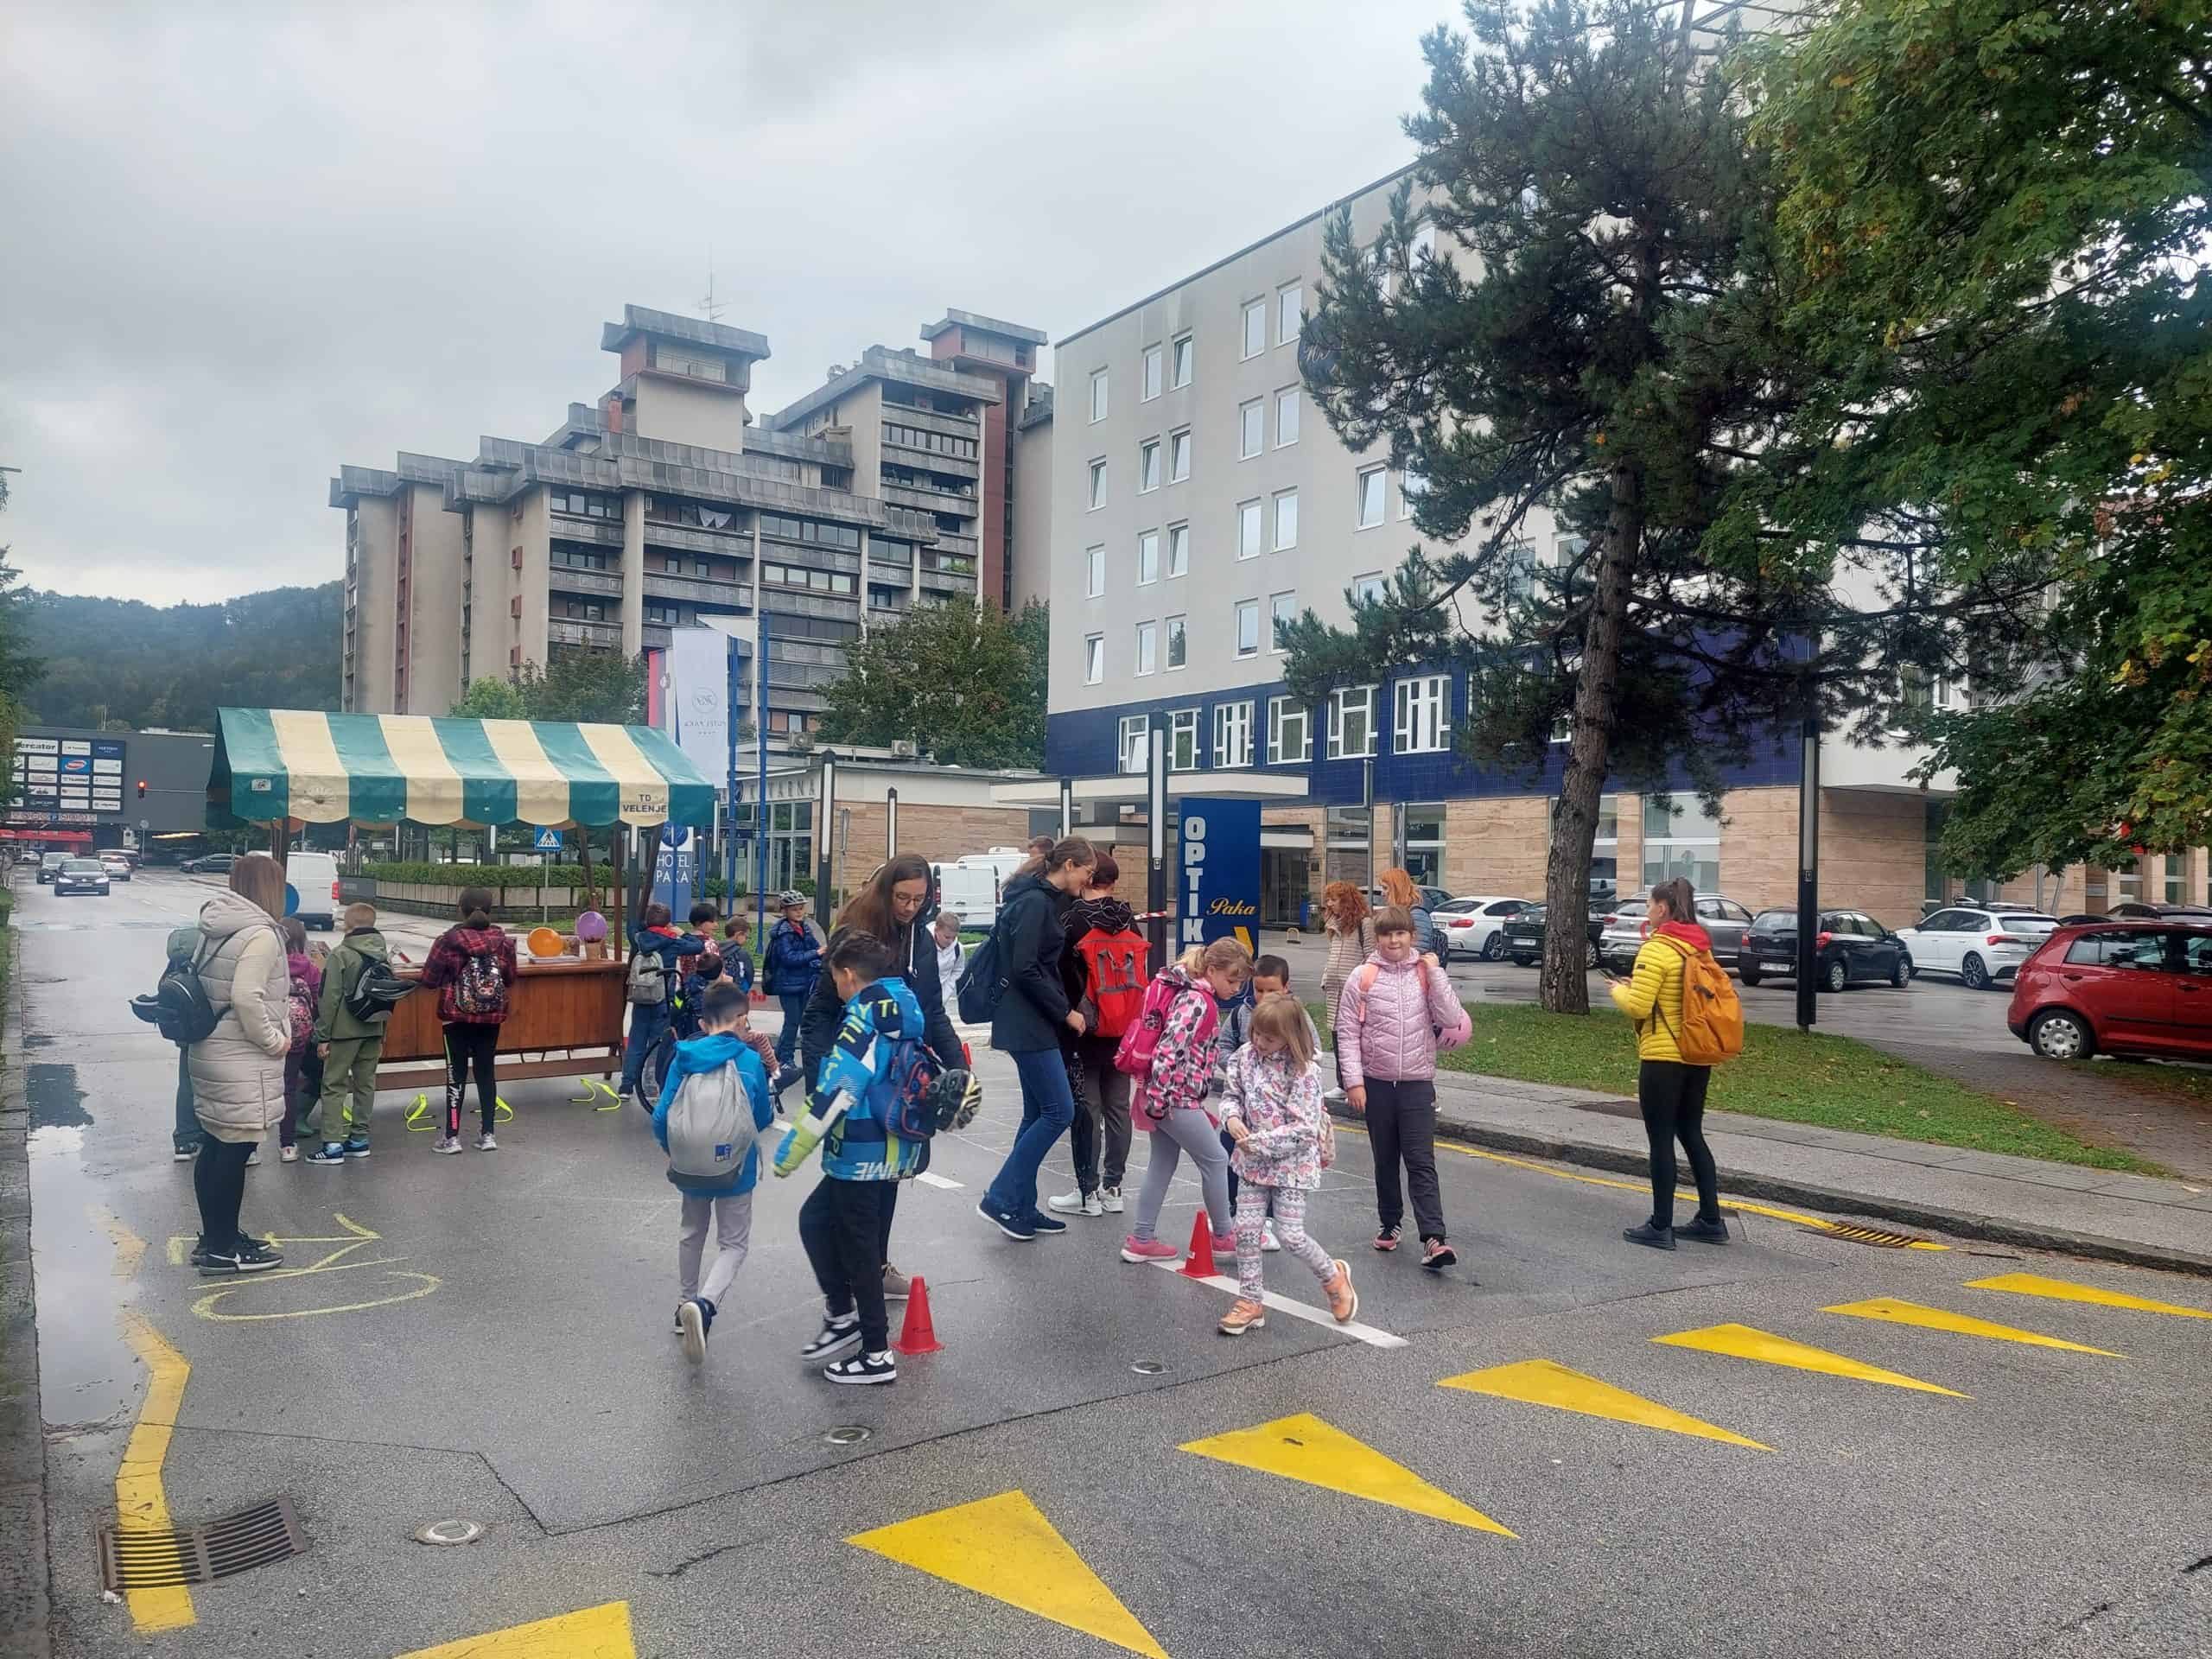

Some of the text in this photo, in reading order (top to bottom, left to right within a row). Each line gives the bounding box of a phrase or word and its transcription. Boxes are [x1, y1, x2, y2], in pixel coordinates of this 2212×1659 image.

[657, 855, 690, 868] HOEL
[1182, 817, 1206, 950] OPTIK
[1206, 897, 1256, 916] Paka
